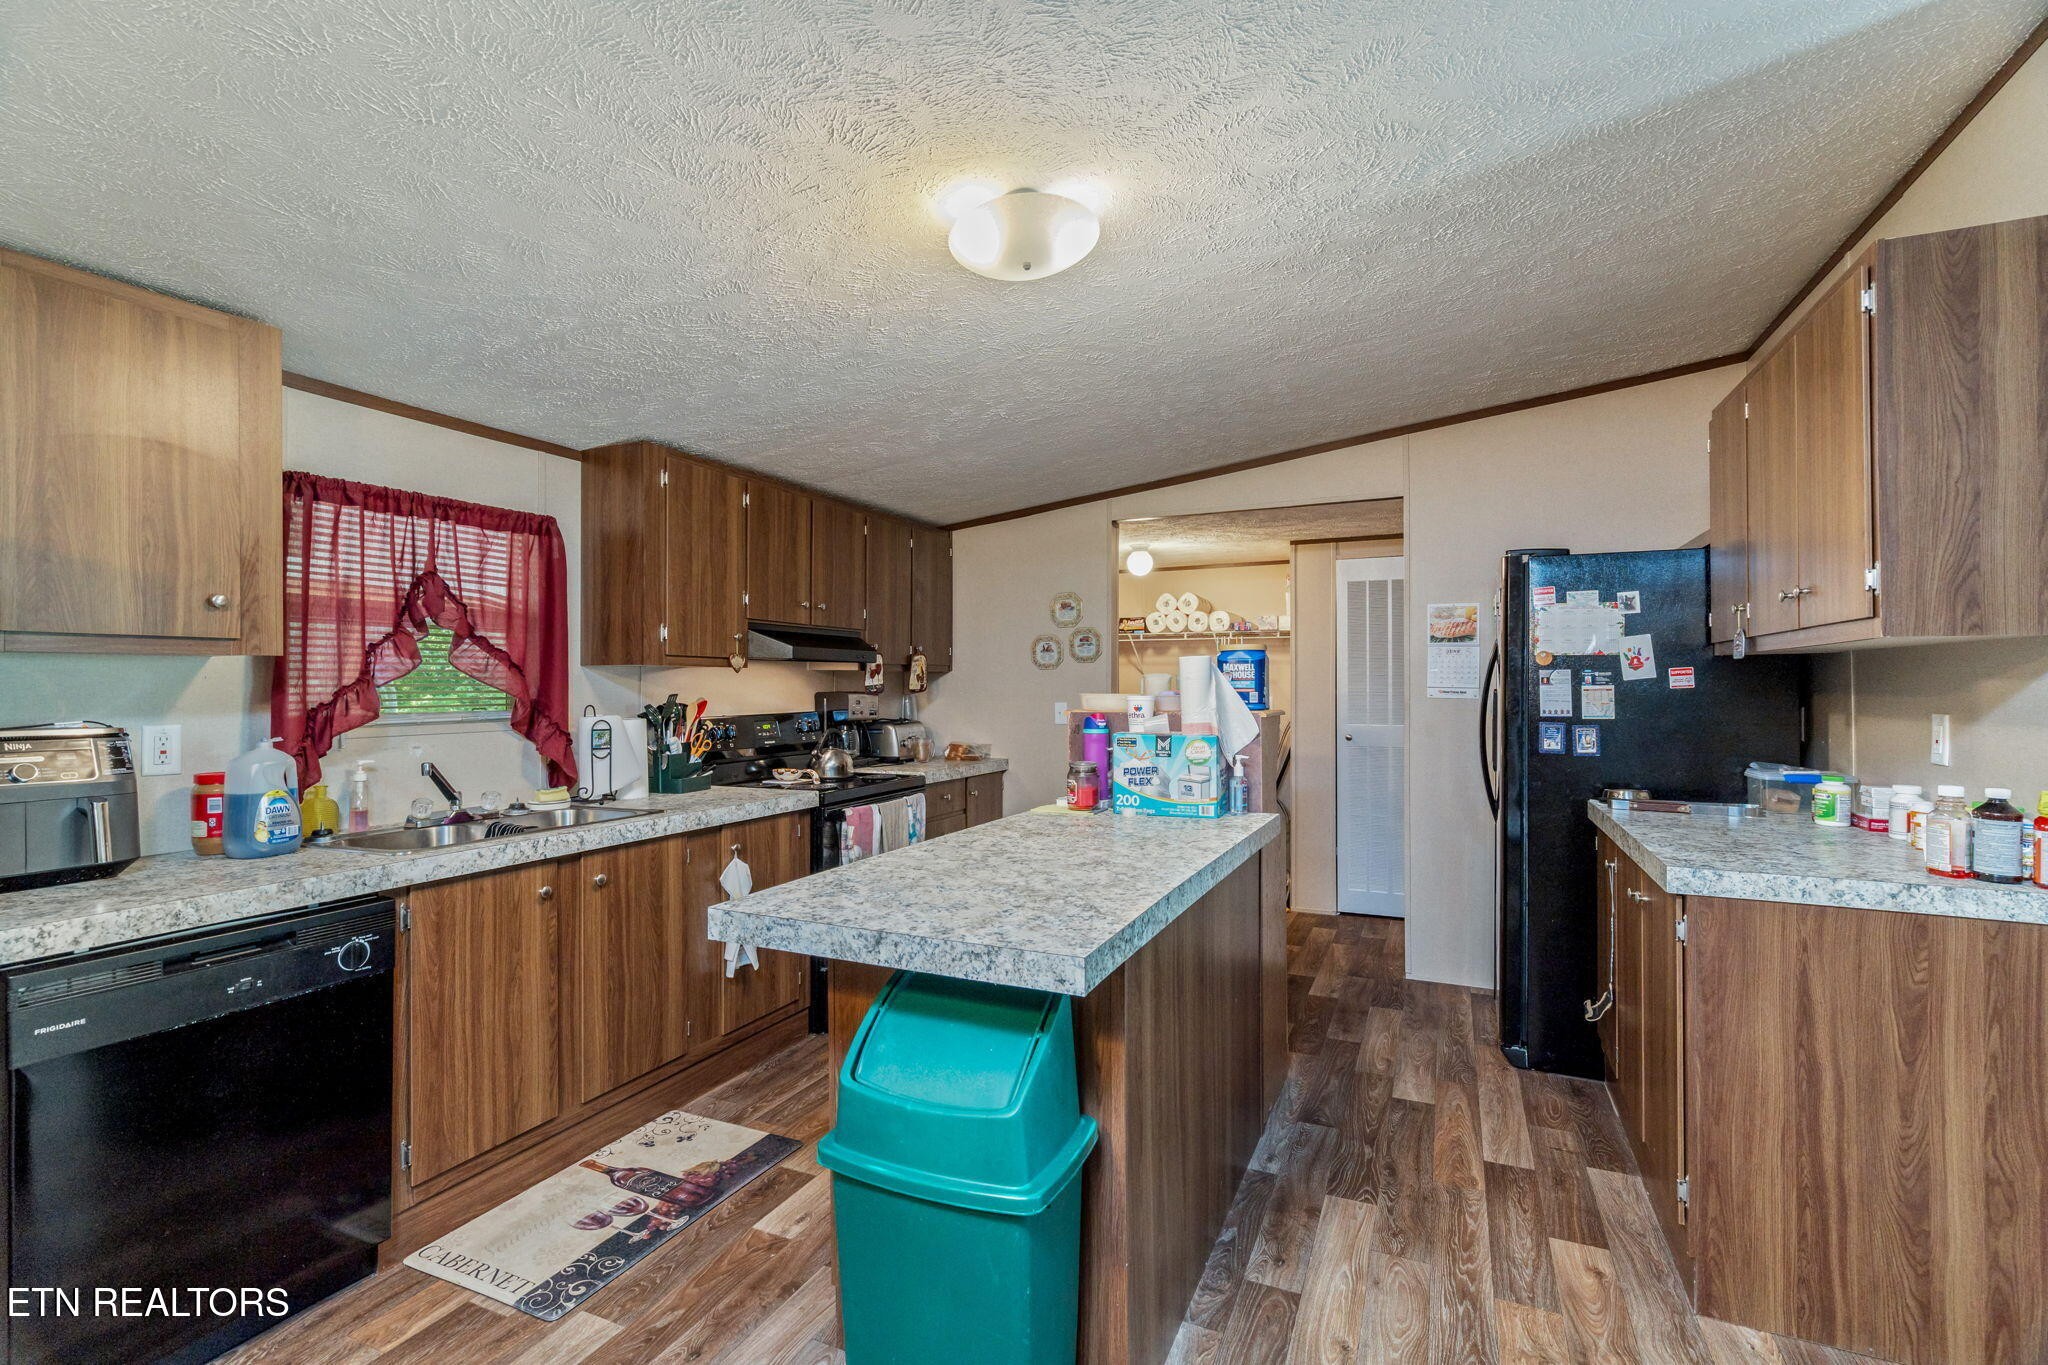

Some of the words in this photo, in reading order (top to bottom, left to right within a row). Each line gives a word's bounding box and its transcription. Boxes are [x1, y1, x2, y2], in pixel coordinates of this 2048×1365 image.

[1222, 663, 1255, 672] MAXWELL
[1232, 670, 1255, 679] HOUSE
[4, 742, 32, 751] NINJA
[1123, 766, 1159, 776] POWER
[1127, 777, 1152, 787] FLEX
[1116, 794, 1140, 806] 200
[265, 805, 290, 815] DAWN
[34, 1018, 87, 1036] FRIGIDAIRE
[418, 1244, 536, 1295] CABERNET
